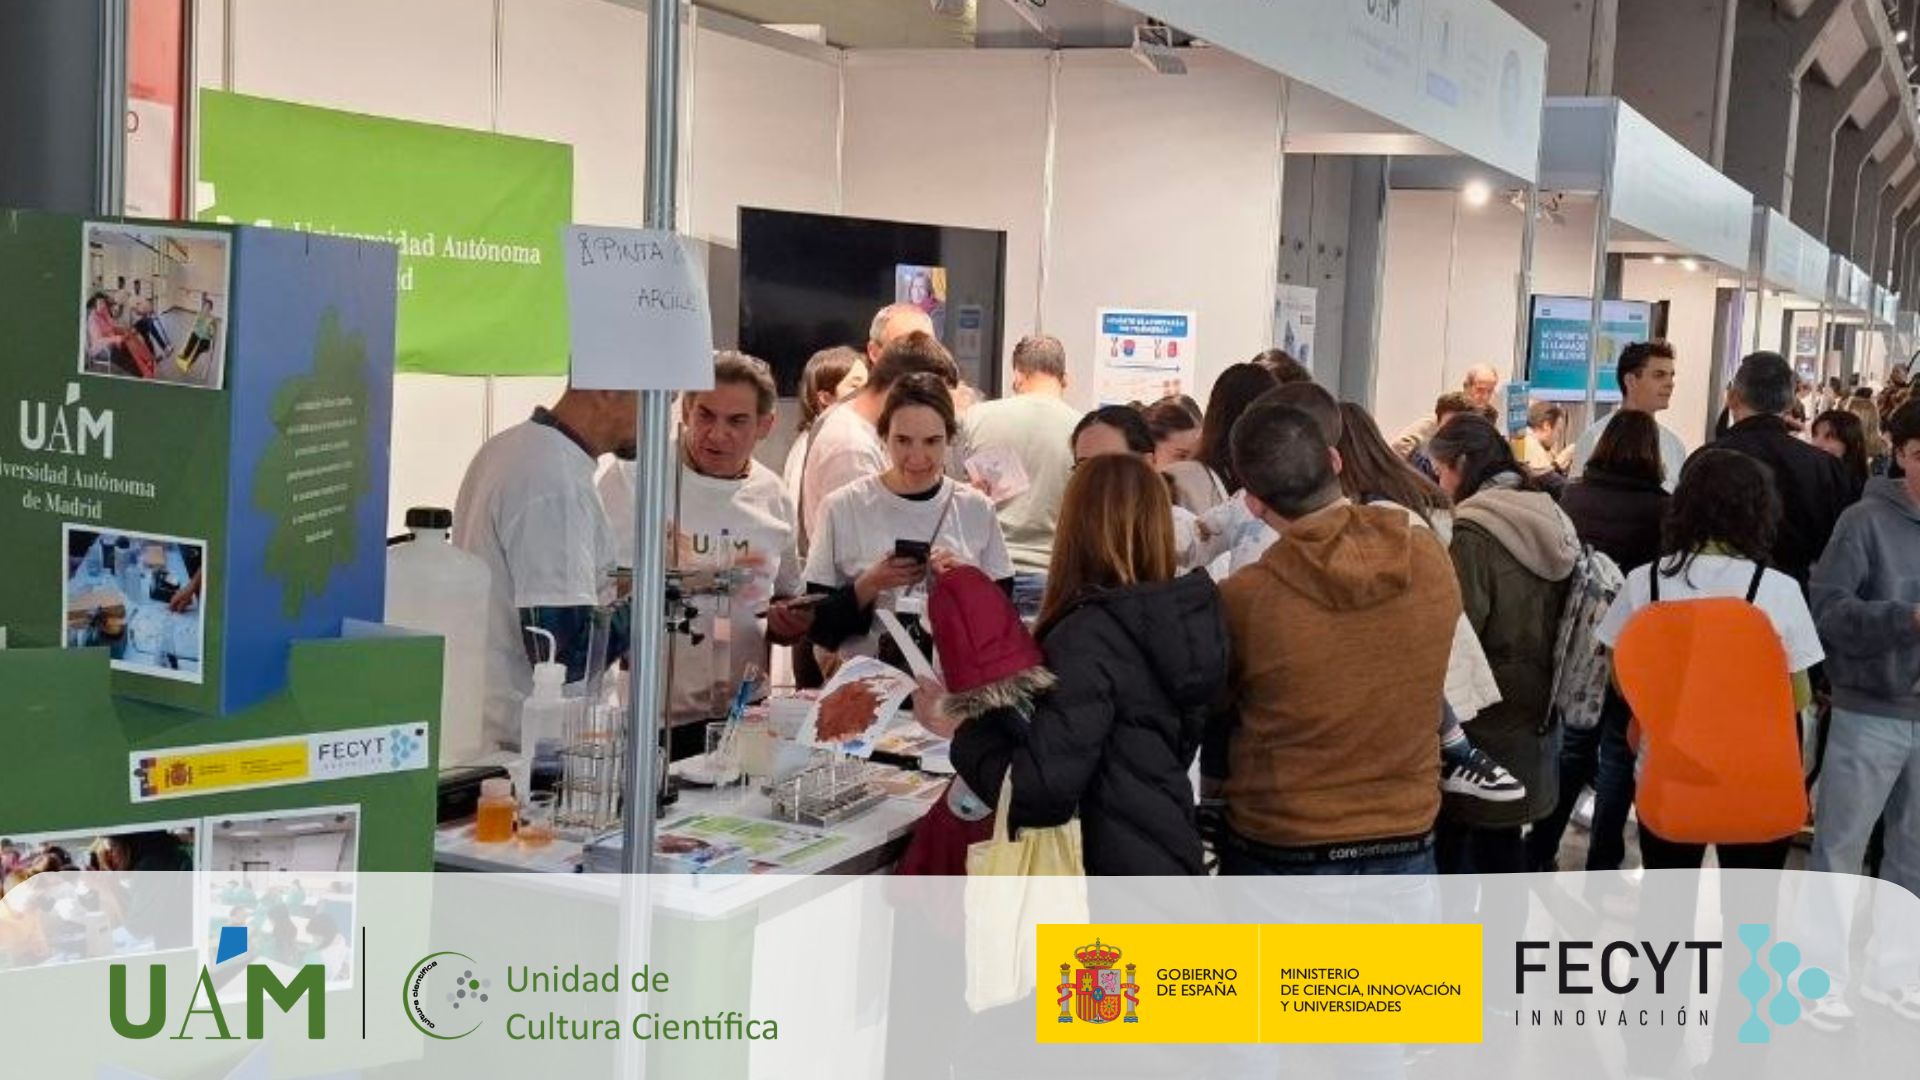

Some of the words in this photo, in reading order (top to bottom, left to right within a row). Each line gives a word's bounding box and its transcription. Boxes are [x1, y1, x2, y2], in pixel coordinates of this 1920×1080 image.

[441, 233, 541, 265] Autónoma
[72, 467, 156, 499] Autónoma
[22, 489, 42, 510] de
[44, 492, 103, 519] Madrid
[319, 737, 386, 761] FECYT
